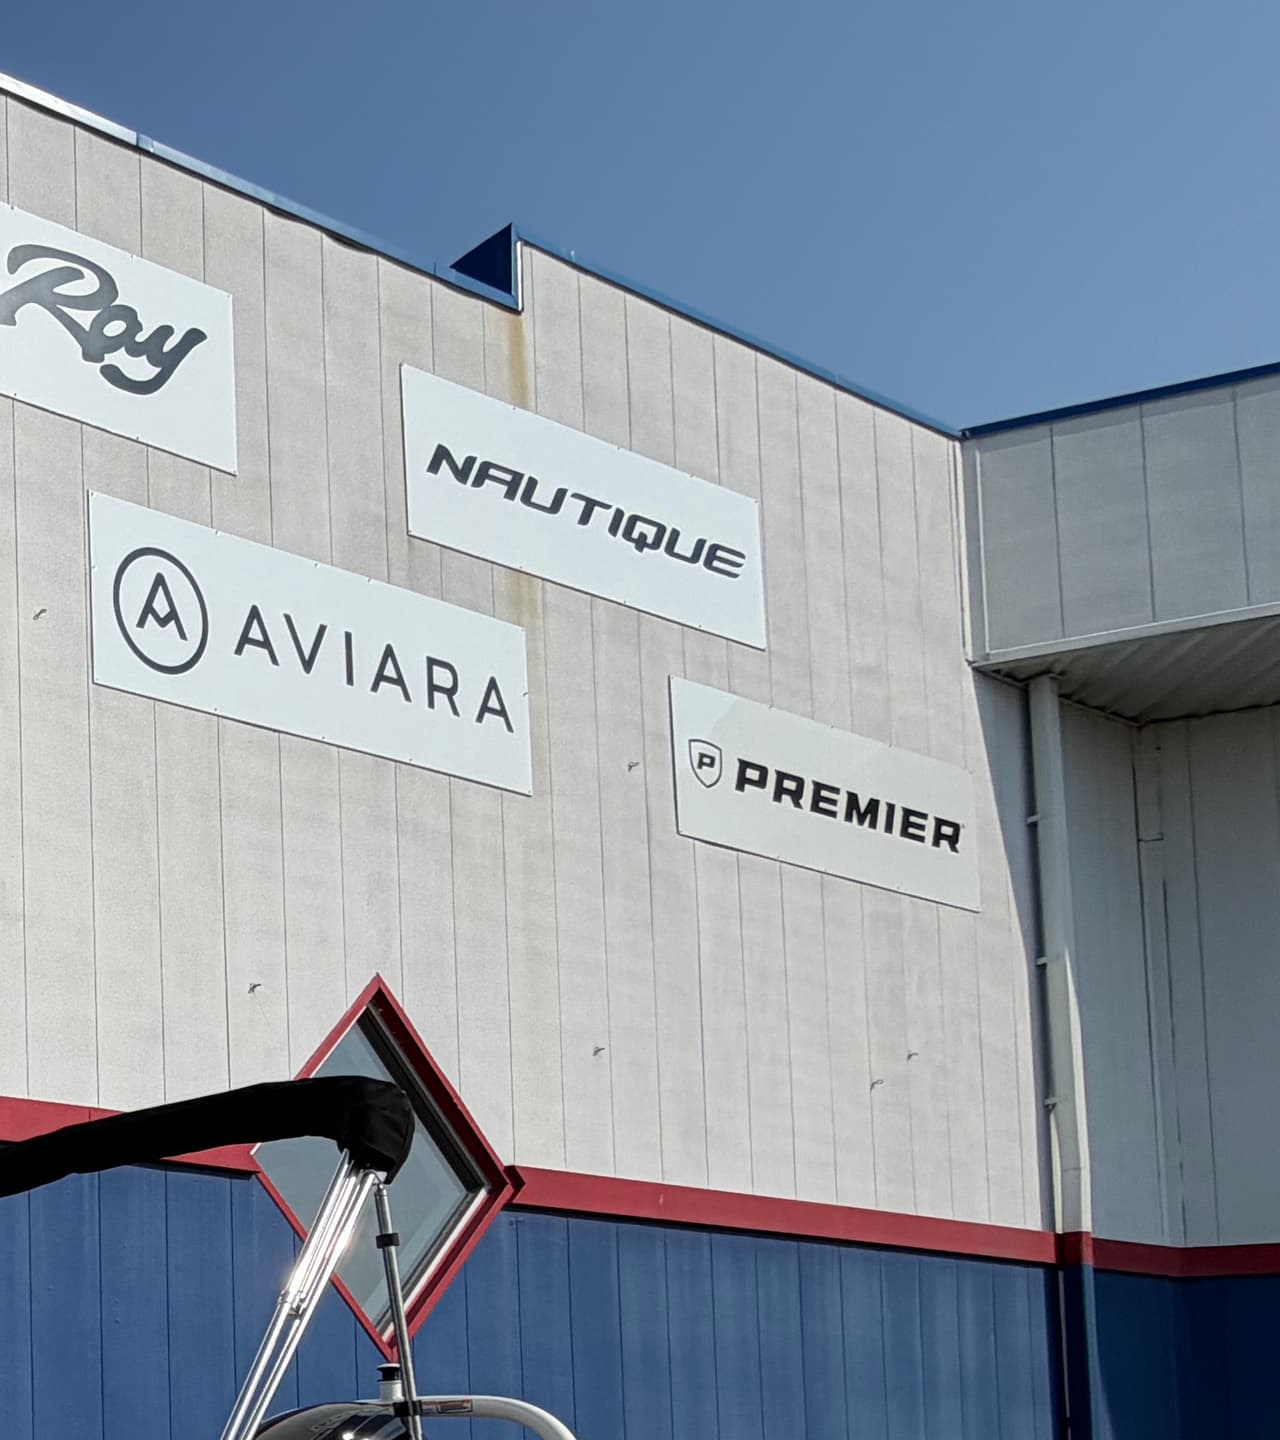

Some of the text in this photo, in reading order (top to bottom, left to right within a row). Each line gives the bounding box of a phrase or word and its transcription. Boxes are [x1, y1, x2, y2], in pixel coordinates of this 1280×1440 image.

[426, 443, 746, 579] NAUTIQUE
[233, 604, 514, 734] AVIARA
[696, 751, 962, 854] P PREMIER
